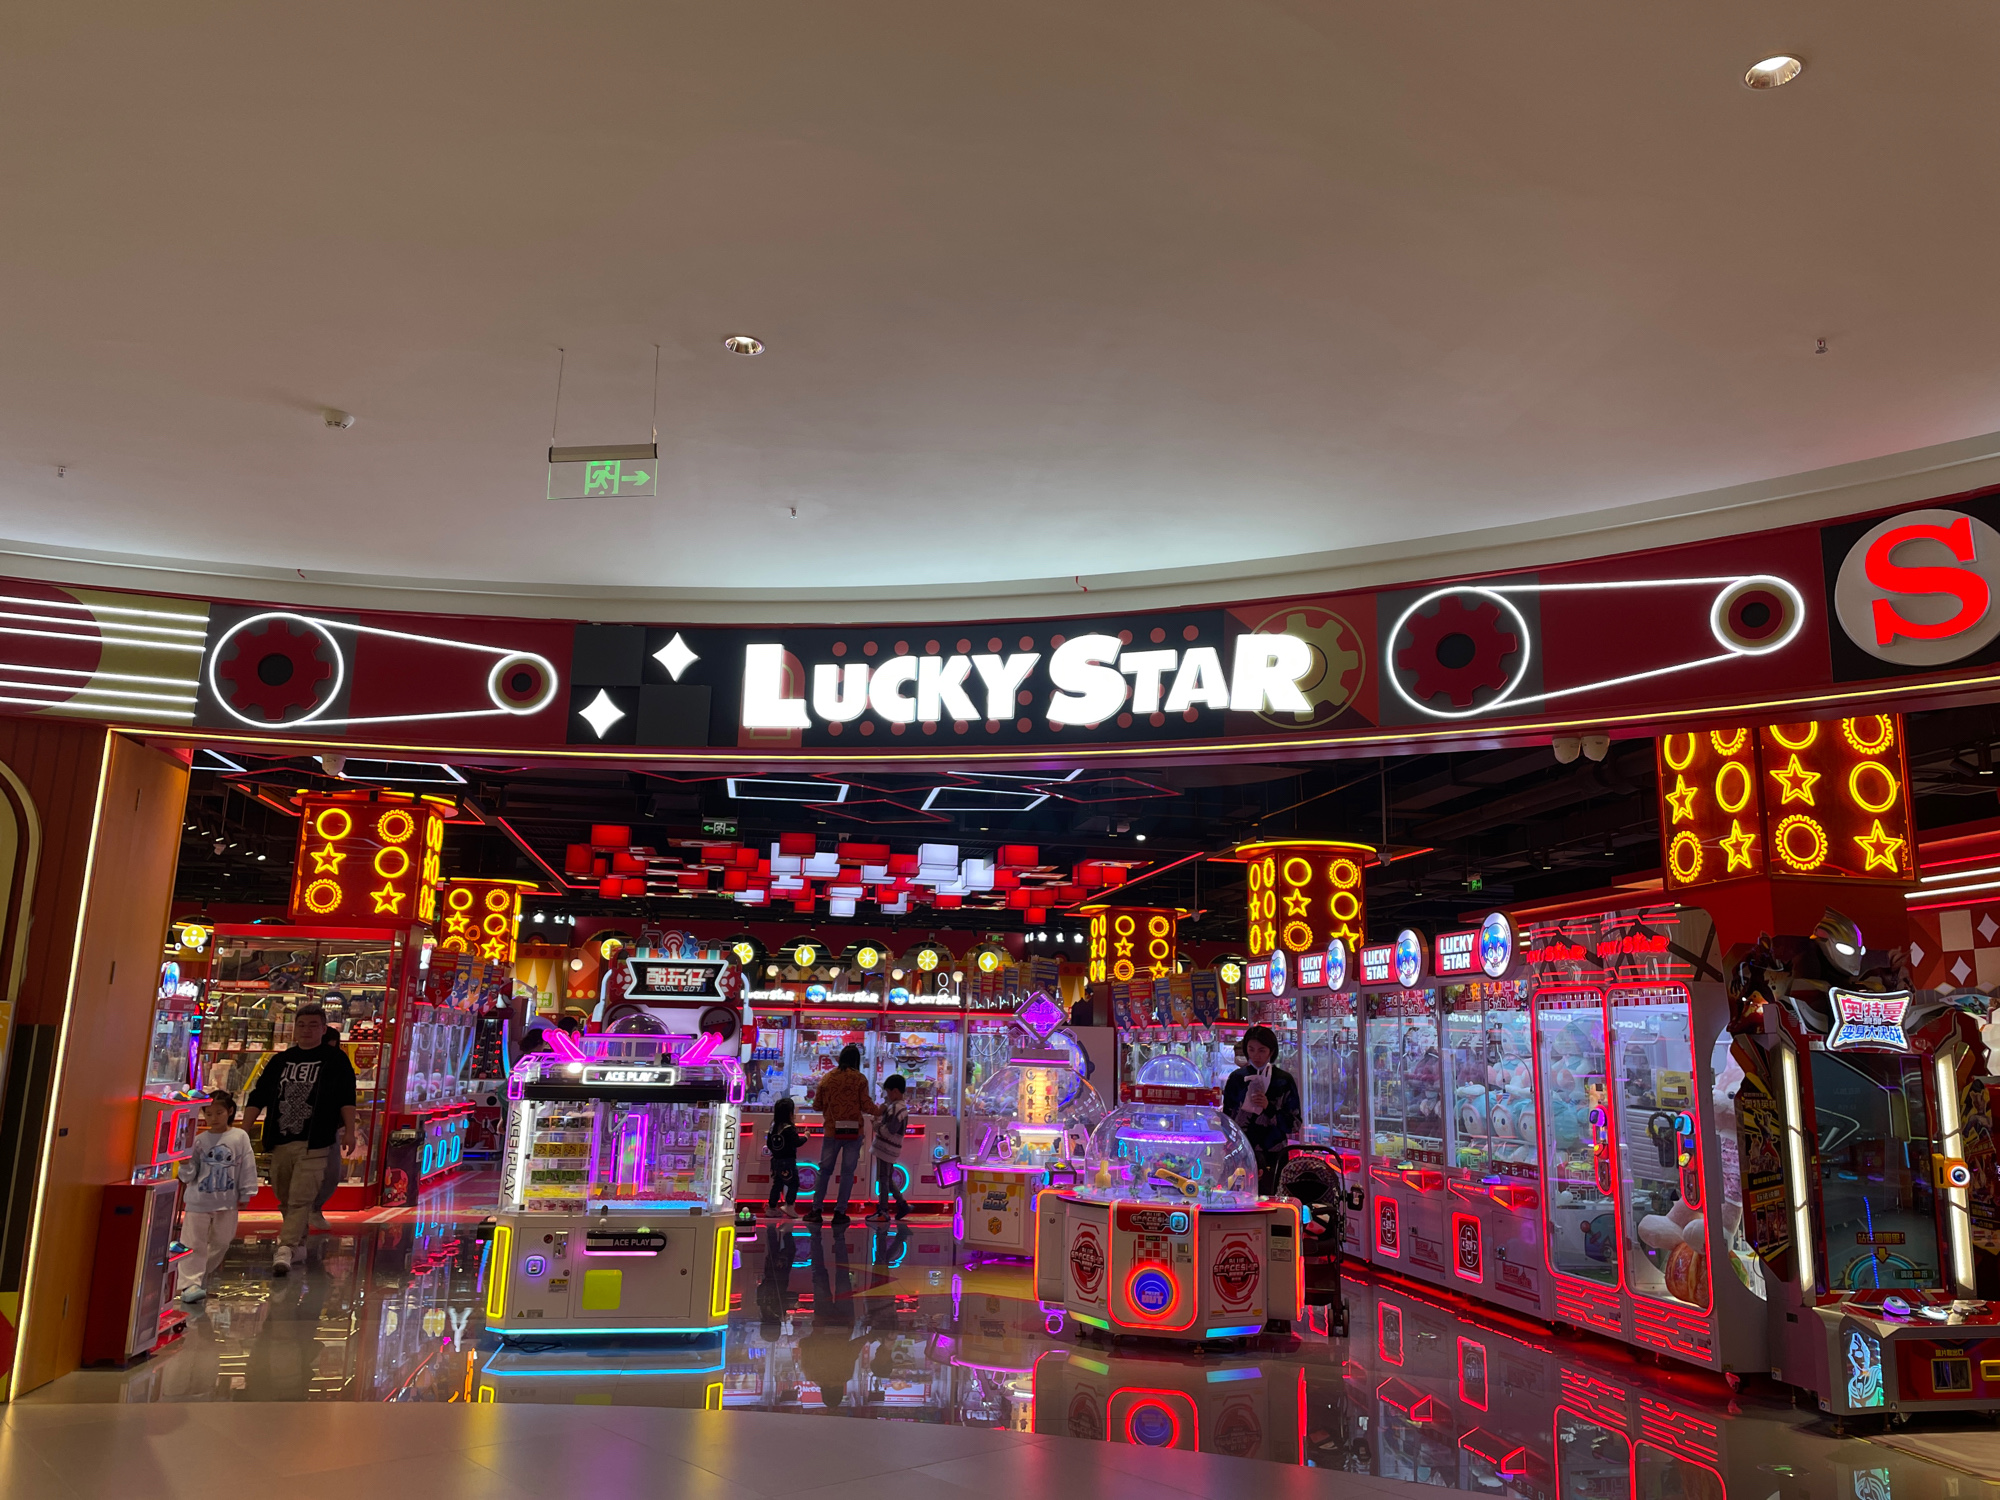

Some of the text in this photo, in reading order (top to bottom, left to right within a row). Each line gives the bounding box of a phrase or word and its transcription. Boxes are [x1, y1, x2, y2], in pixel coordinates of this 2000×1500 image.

[1865, 517, 1990, 646] S
[742, 633, 1313, 729] LUCKY STAR
[1439, 933, 1475, 955] LUCKY
[1300, 955, 1323, 972] LUCKY
[1363, 947, 1391, 967] LUCKY
[1443, 952, 1471, 971] STAR
[1248, 964, 1268, 979] LUCKY
[1302, 970, 1320, 984] STAR
[1366, 965, 1389, 981] STAR
[1249, 978, 1265, 991] STAR
[1840, 998, 1905, 1022] 奥特曼
[1838, 1025, 1904, 1044] 变身大决战
[604, 1071, 652, 1082] ACE PLAY
[504, 1110, 522, 1200] ACE PLAY
[719, 1114, 737, 1201] ACE PLAY
[987, 1191, 1007, 1200] POP
[982, 1199, 1009, 1212] BOX
[614, 1238, 650, 1246] ACE PLAY
